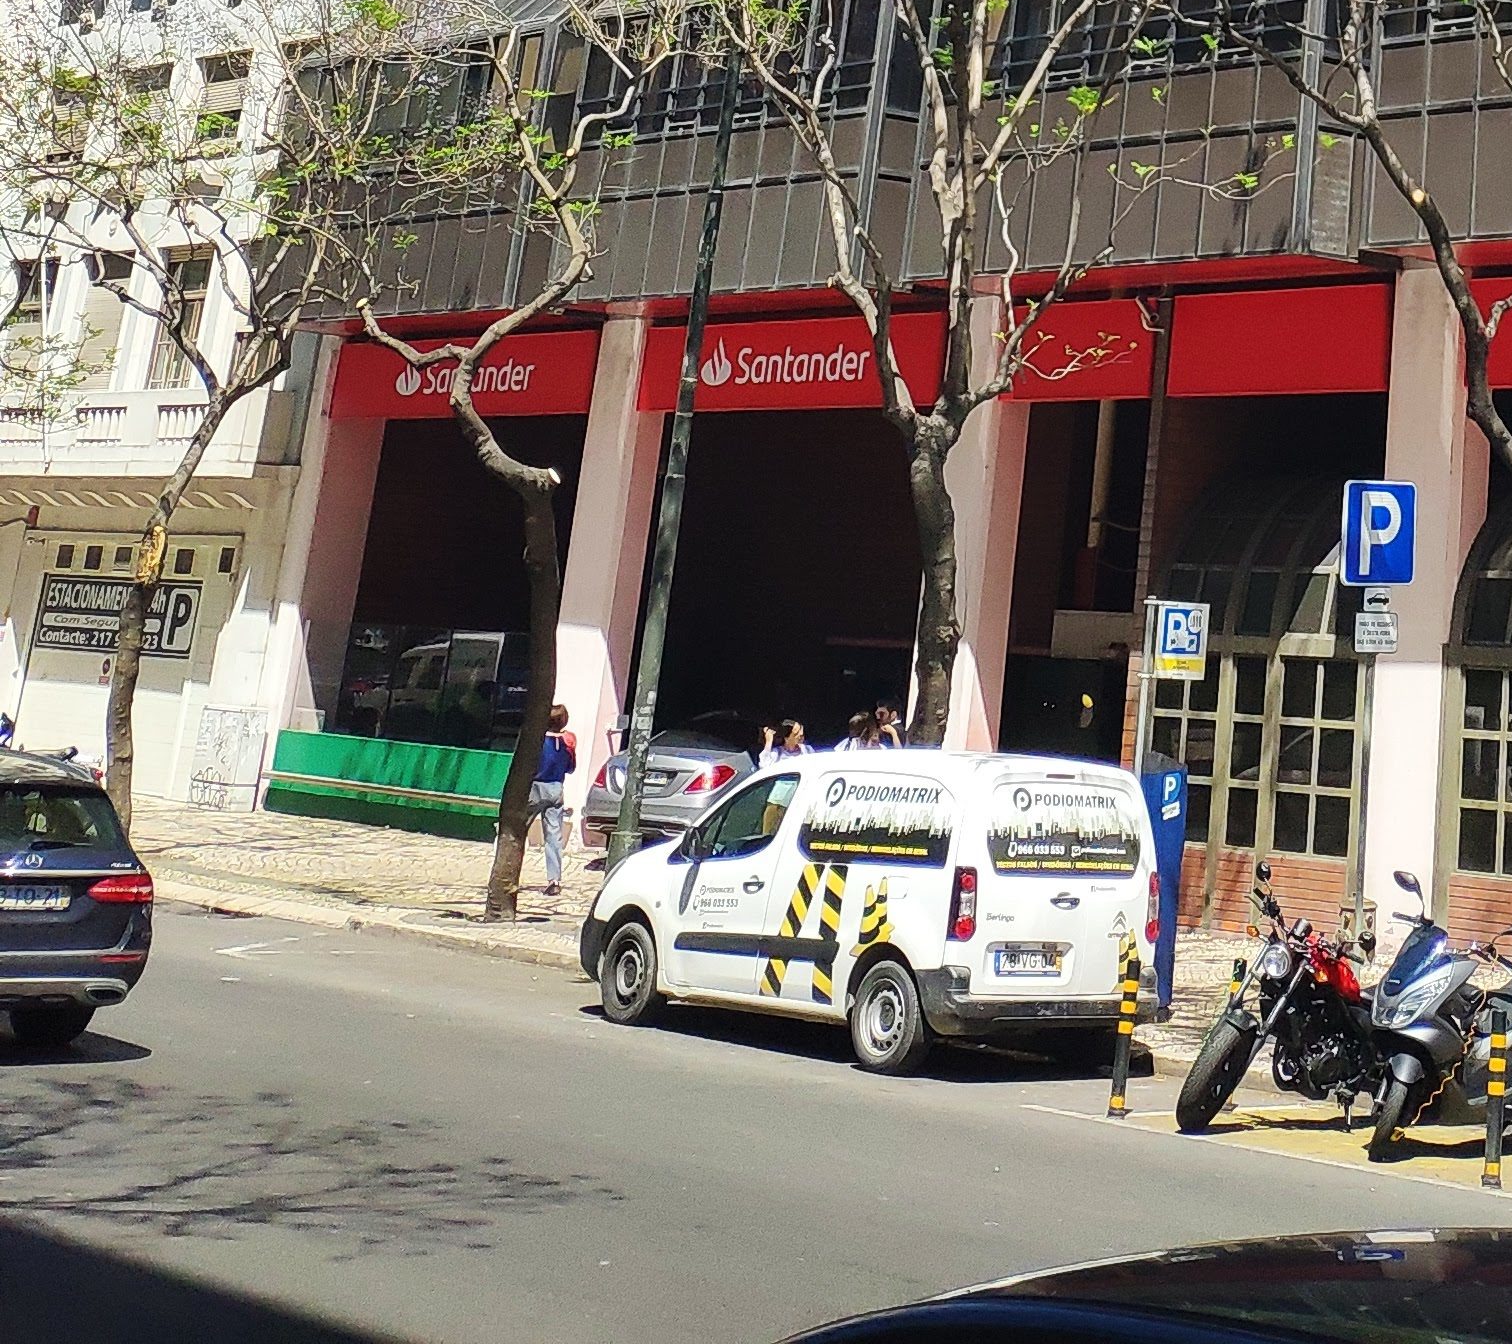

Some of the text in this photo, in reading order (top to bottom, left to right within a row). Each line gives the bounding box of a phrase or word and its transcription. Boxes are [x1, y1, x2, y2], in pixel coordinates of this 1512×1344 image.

[735, 344, 871, 384] Santander
[423, 359, 535, 395] Saander
[1359, 491, 1401, 575] P
[47, 582, 134, 610] ESTACIONAMEN
[53, 614, 119, 628] Com Segur
[166, 594, 193, 646] P
[40, 628, 89, 645] Contacte:
[91, 631, 111, 646] 217
[846, 785, 944, 804] PODIOMATRIX
[1165, 777, 1176, 800] P
[1034, 794, 1117, 809] PODIOMATRIX
[986, 912, 1015, 923] Berlingo
